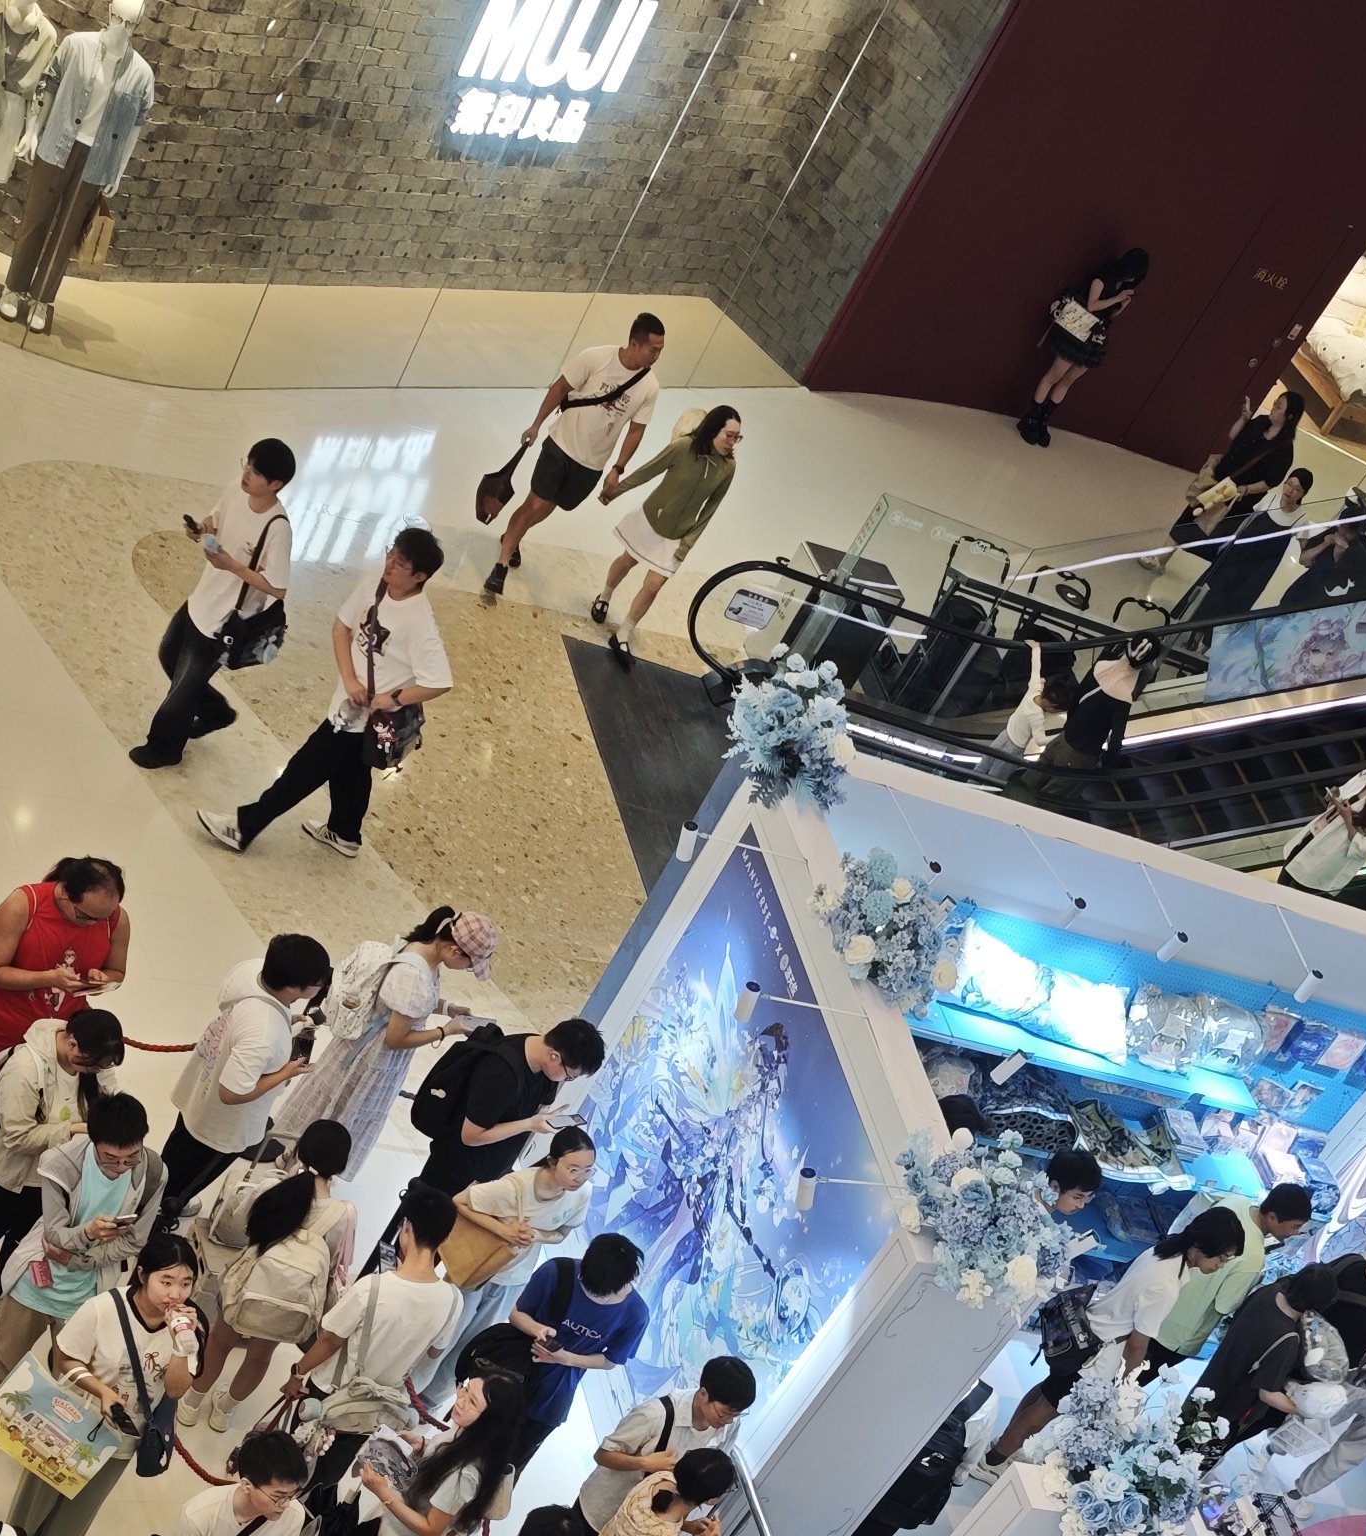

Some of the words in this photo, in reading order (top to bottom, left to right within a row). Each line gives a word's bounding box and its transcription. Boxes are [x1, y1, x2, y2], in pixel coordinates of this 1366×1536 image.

[457, 0, 660, 93] MUJI
[1253, 267, 1288, 290] 消火栓
[741, 849, 772, 925] MANVERSE
[561, 1319, 602, 1340] AUTICA
